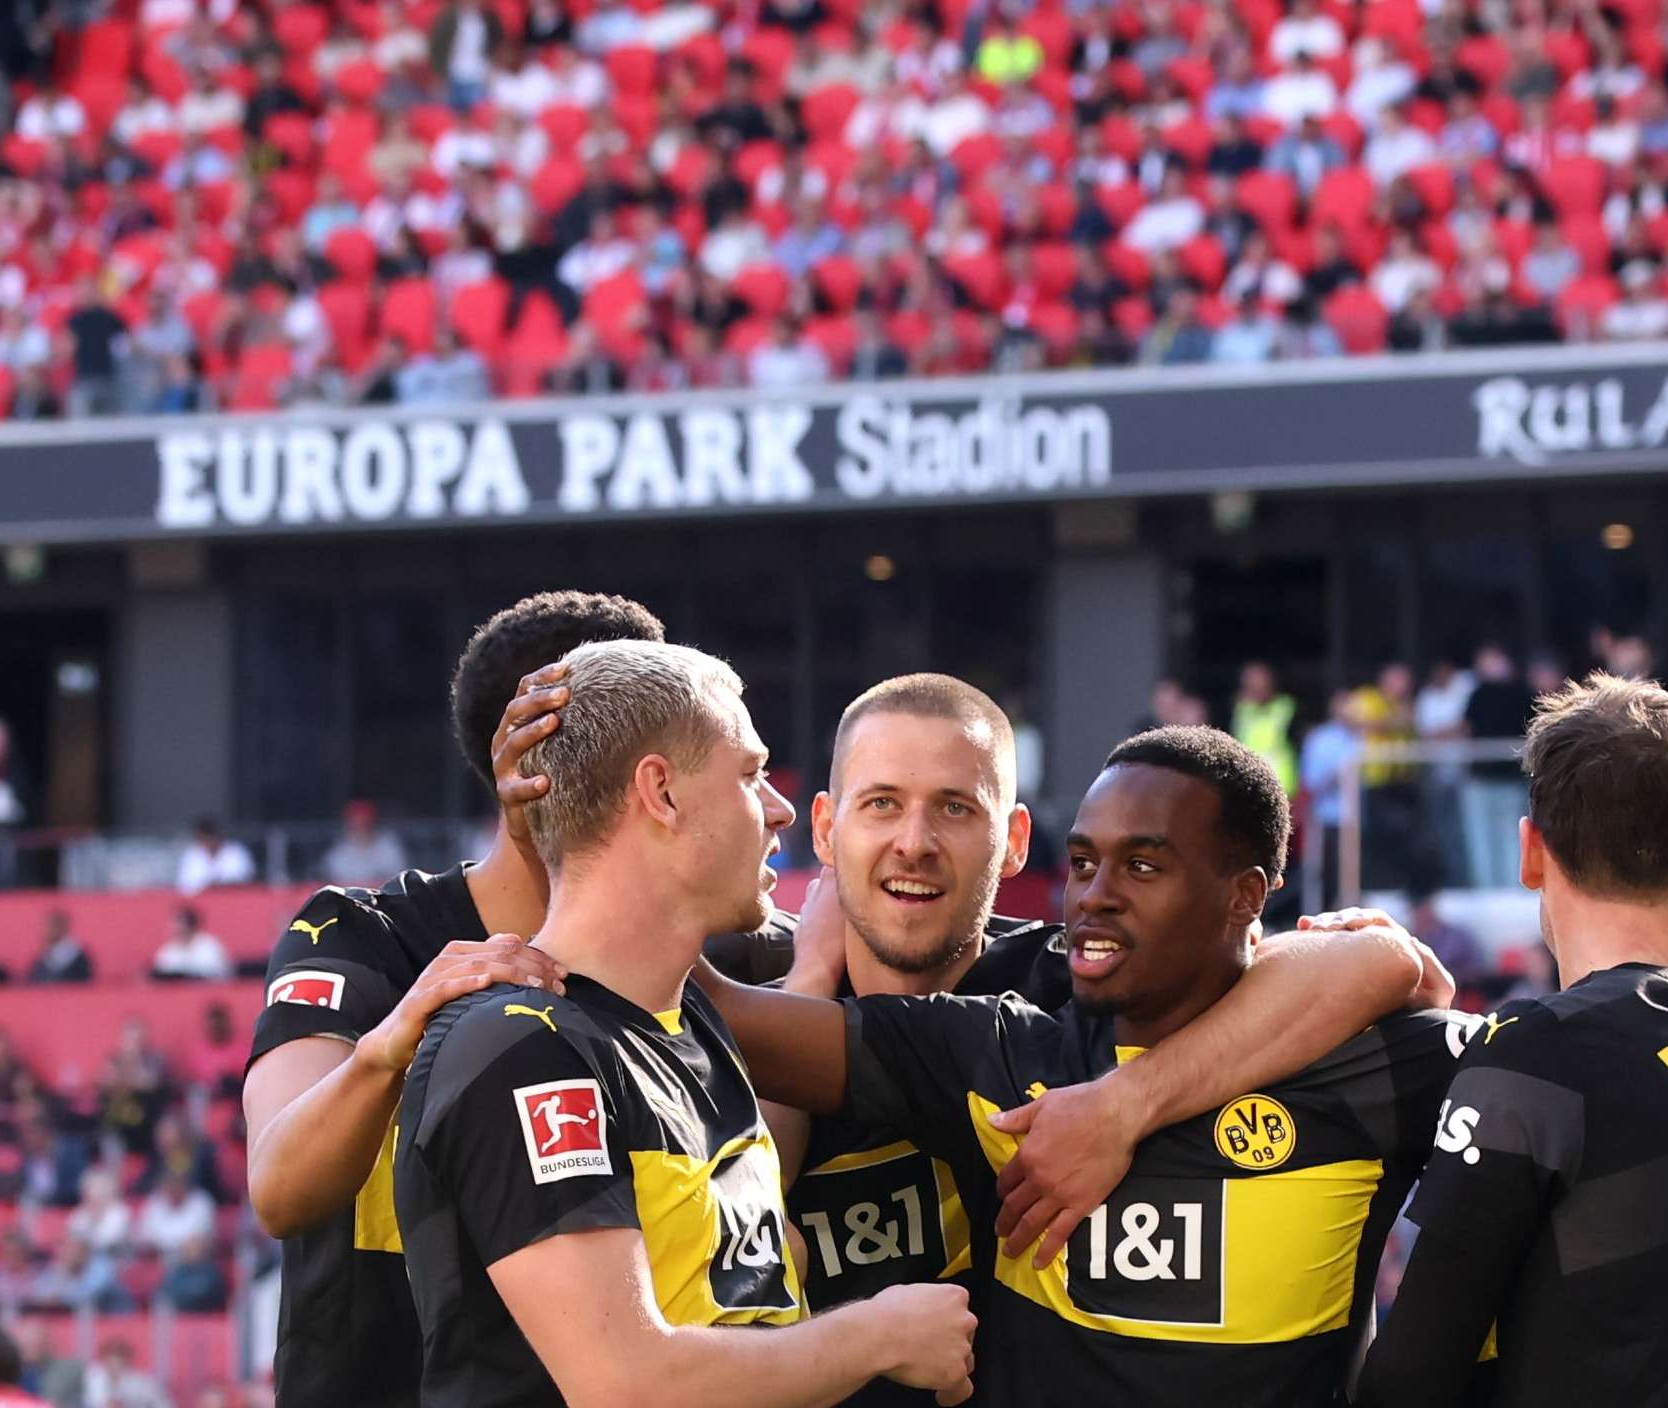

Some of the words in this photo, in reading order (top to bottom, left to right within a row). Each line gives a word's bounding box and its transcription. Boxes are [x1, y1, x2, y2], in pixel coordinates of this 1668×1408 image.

[156, 418, 531, 529] EUROPA
[556, 404, 815, 512] PARK
[835, 398, 1112, 499] Stadion
[1225, 1103, 1286, 1155] BVB
[1252, 1146, 1275, 1162] 09
[540, 1157, 605, 1174] BUNDESLIGA
[802, 1185, 926, 1277] 1&1
[1086, 1203, 1203, 1281] 1&1
